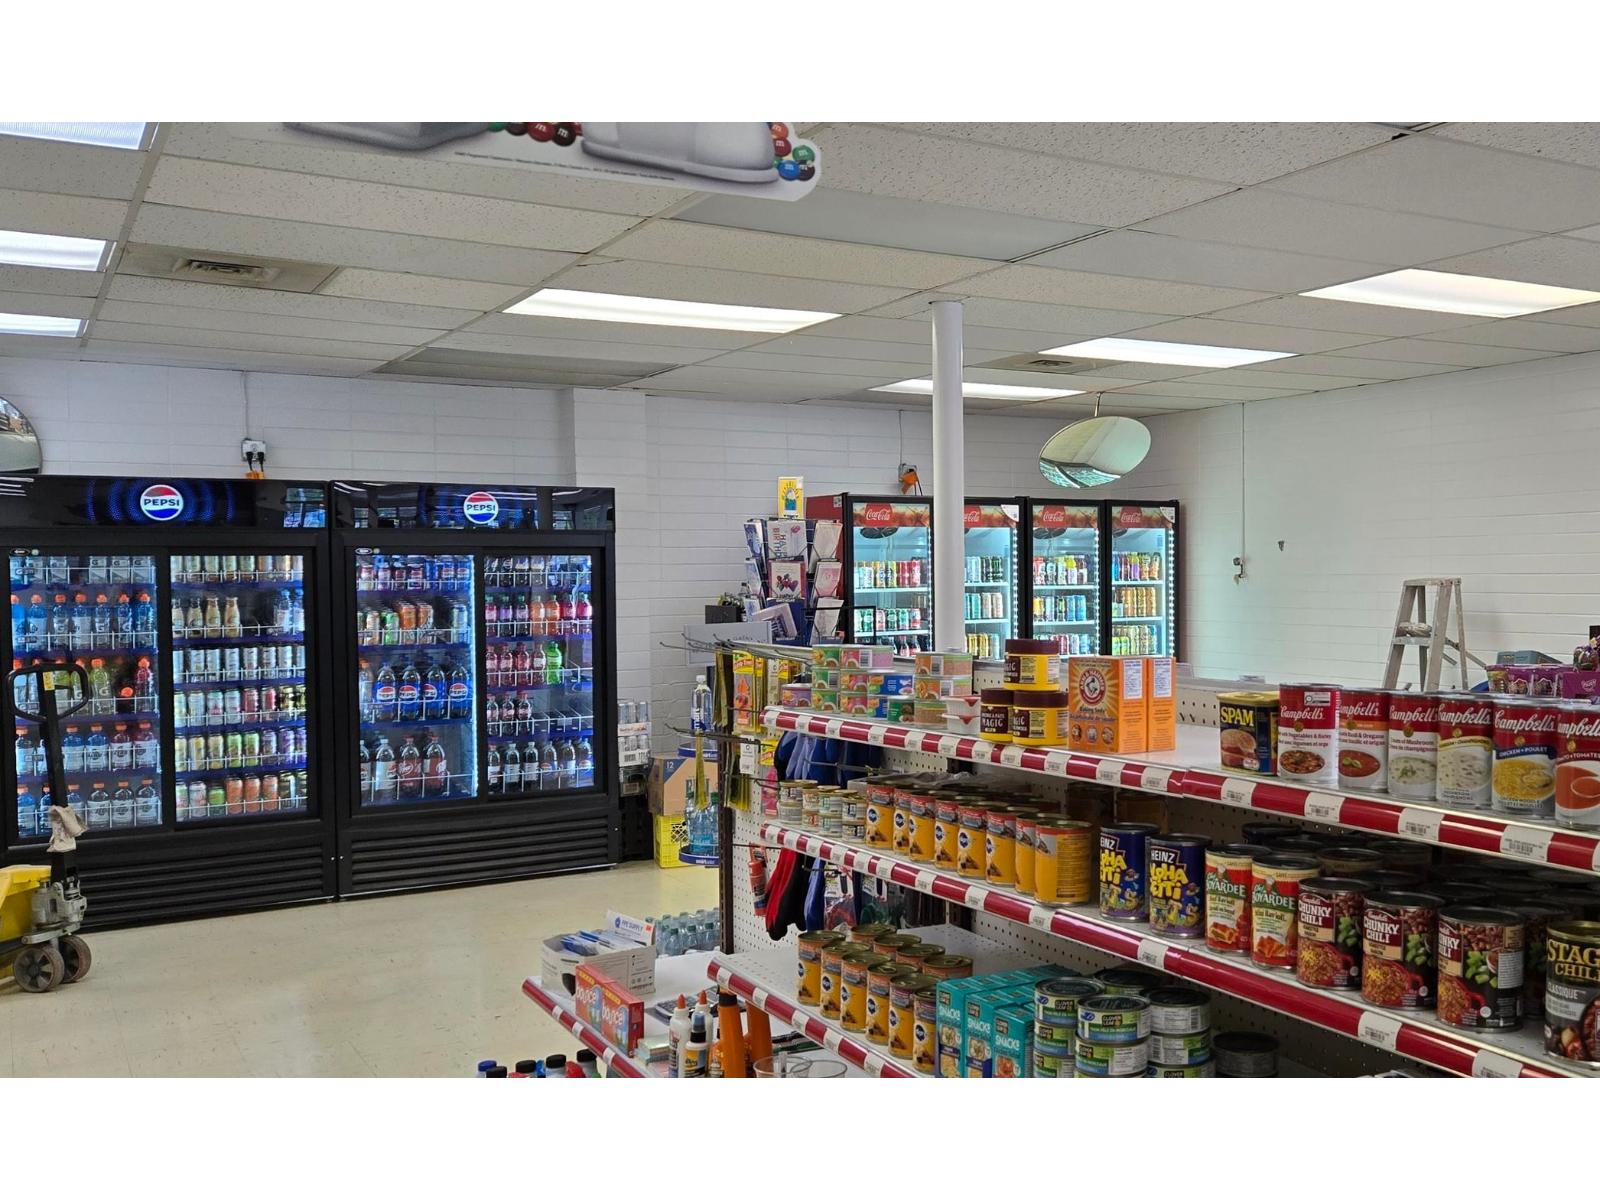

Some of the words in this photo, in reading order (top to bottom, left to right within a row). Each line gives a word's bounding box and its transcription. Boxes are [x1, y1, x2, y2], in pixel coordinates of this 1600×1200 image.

[143, 498, 180, 506] PEPSI
[1221, 706, 1254, 727] SPAM
[1280, 705, 1323, 721] Campbell's
[1340, 702, 1380, 717] mpbell's
[1438, 704, 1492, 726] Campbell's
[1494, 710, 1557, 734] Campbell's
[1557, 718, 1600, 738] mpbell
[666, 761, 674, 769] 12
[1151, 850, 1176, 864] HEINZ
[1299, 900, 1332, 917] CHUNKY
[1301, 912, 1322, 926] CHILI
[1364, 916, 1400, 935] CHUNKY
[1366, 930, 1390, 944] CHILI
[1548, 939, 1600, 968] STAG
[939, 1006, 960, 1020] SNACKS
[968, 1018, 992, 1034] SNACKS
[995, 1034, 1020, 1051] SNACKS
